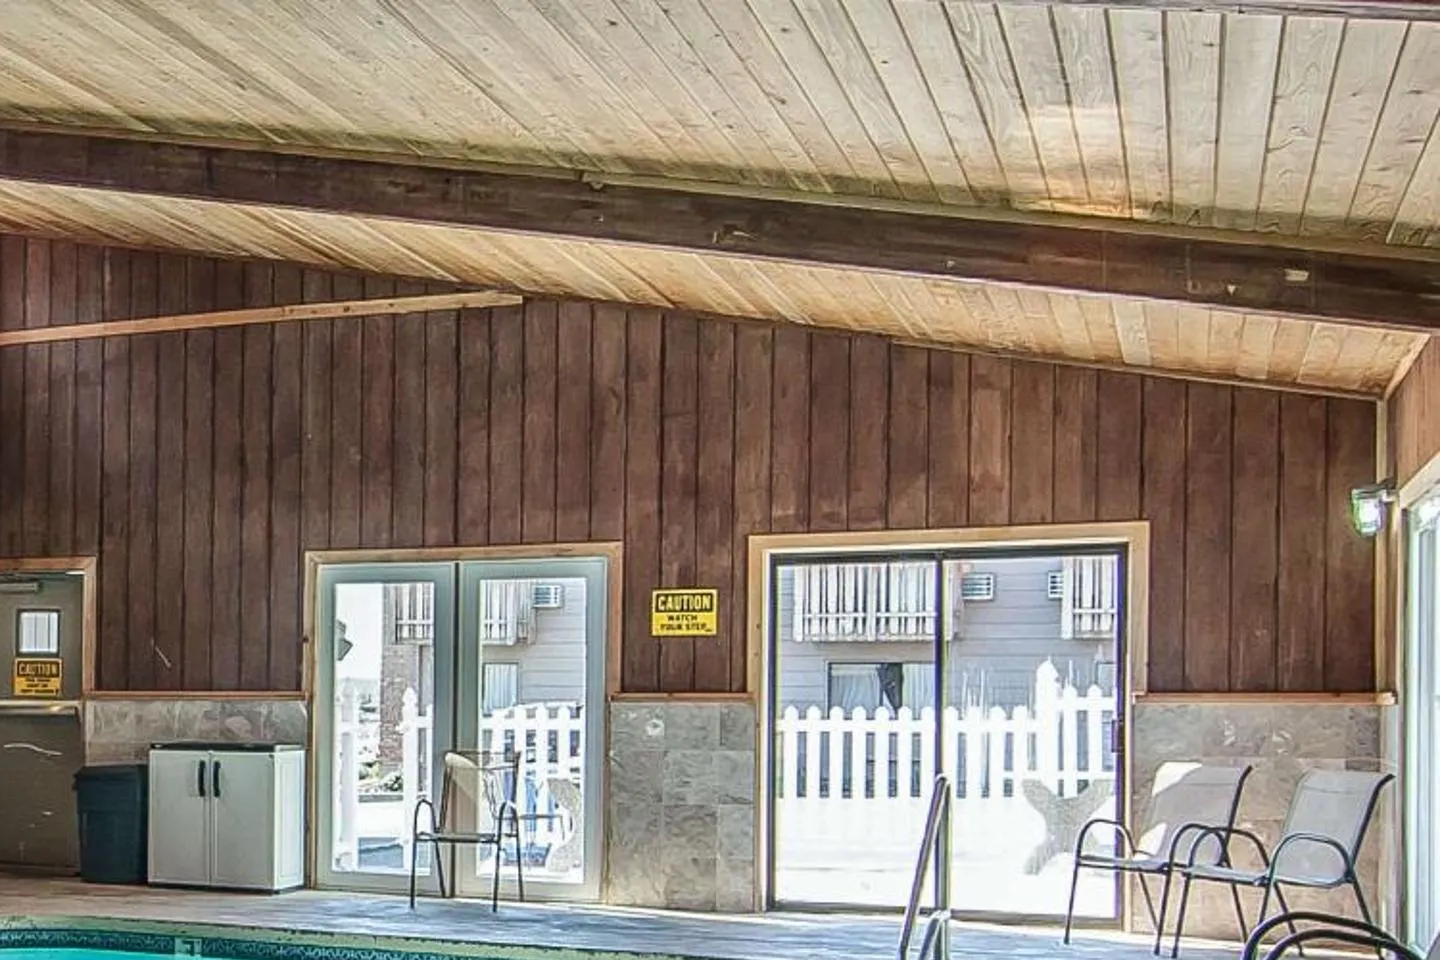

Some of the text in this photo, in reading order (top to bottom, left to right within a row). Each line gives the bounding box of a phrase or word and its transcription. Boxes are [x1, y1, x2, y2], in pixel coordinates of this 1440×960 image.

[658, 595, 711, 611] CAUTION
[667, 614, 699, 622] WATCH
[19, 663, 58, 676] CAUTION
